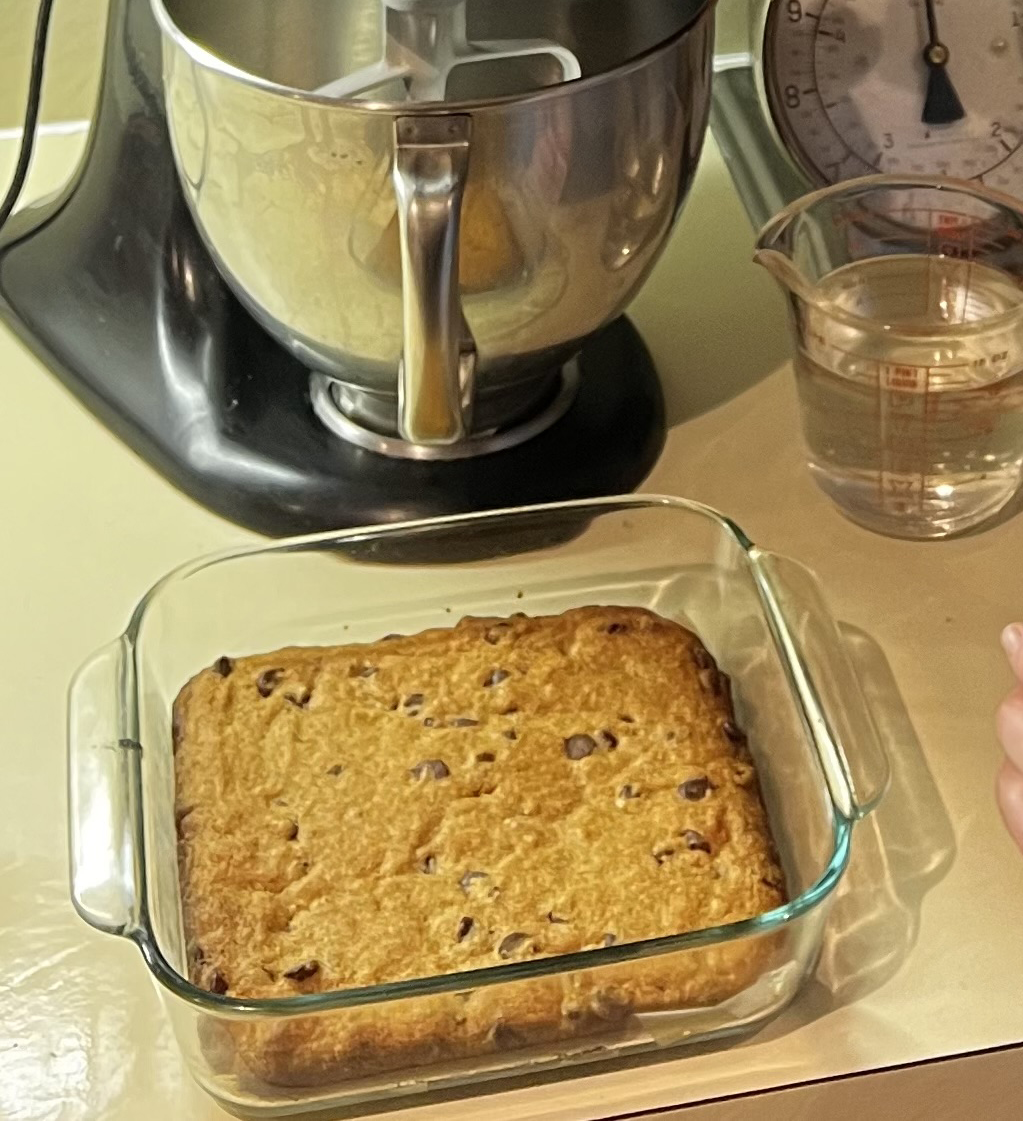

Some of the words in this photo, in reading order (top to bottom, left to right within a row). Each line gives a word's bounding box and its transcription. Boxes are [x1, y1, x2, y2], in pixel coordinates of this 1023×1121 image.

[784, 85, 800, 109] 8
[991, 122, 1002, 139] 2
[882, 132, 895, 149] 3
